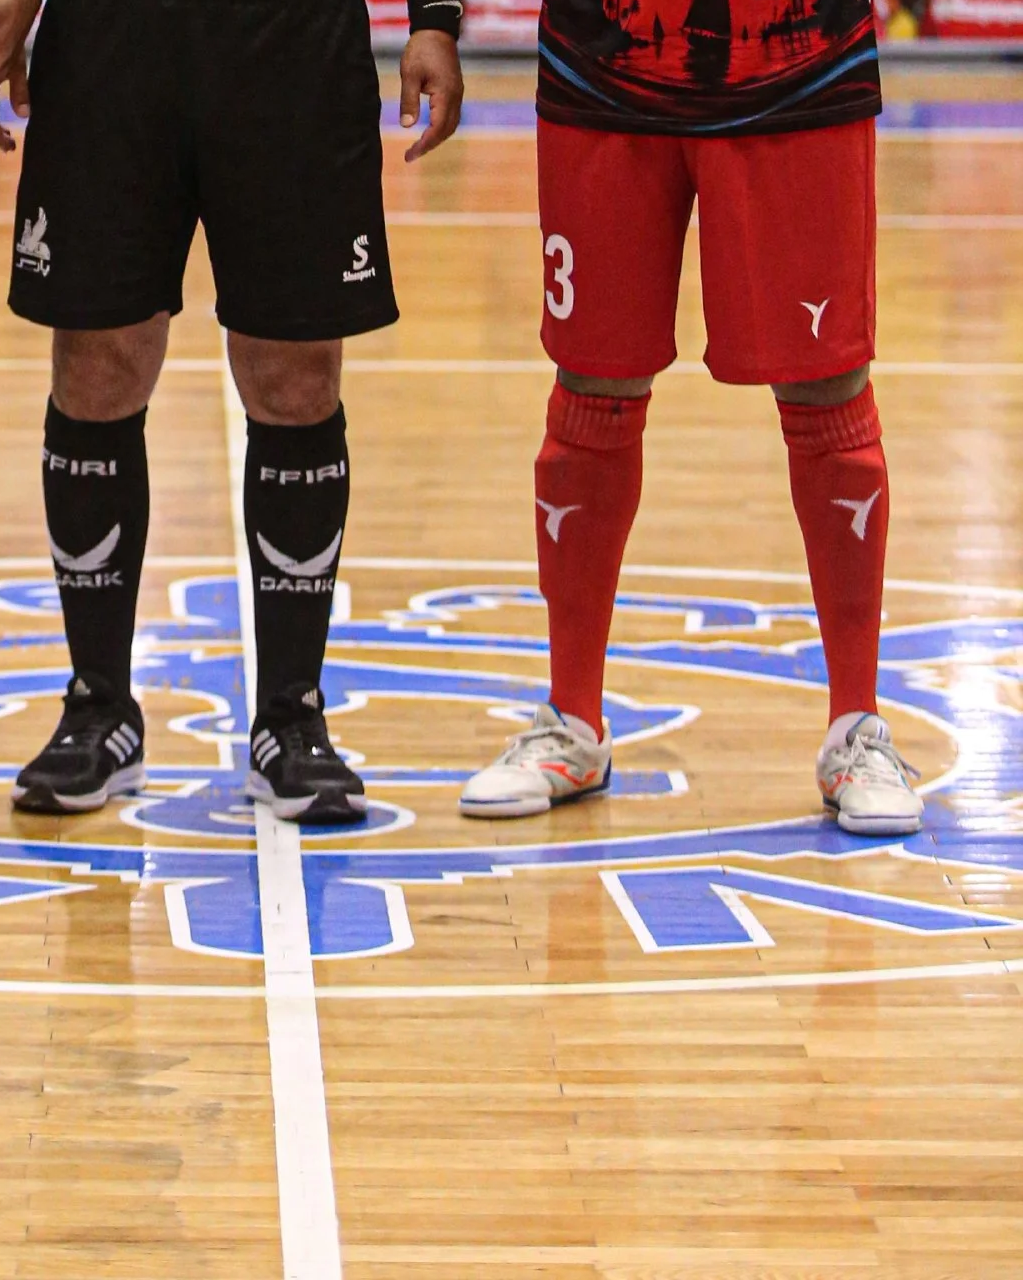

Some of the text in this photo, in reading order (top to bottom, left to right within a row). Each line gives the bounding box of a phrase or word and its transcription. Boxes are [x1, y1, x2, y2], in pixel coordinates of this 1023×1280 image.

[545, 233, 574, 320] 3
[260, 460, 346, 485] FFIRI
[259, 577, 335, 593] DARIK
